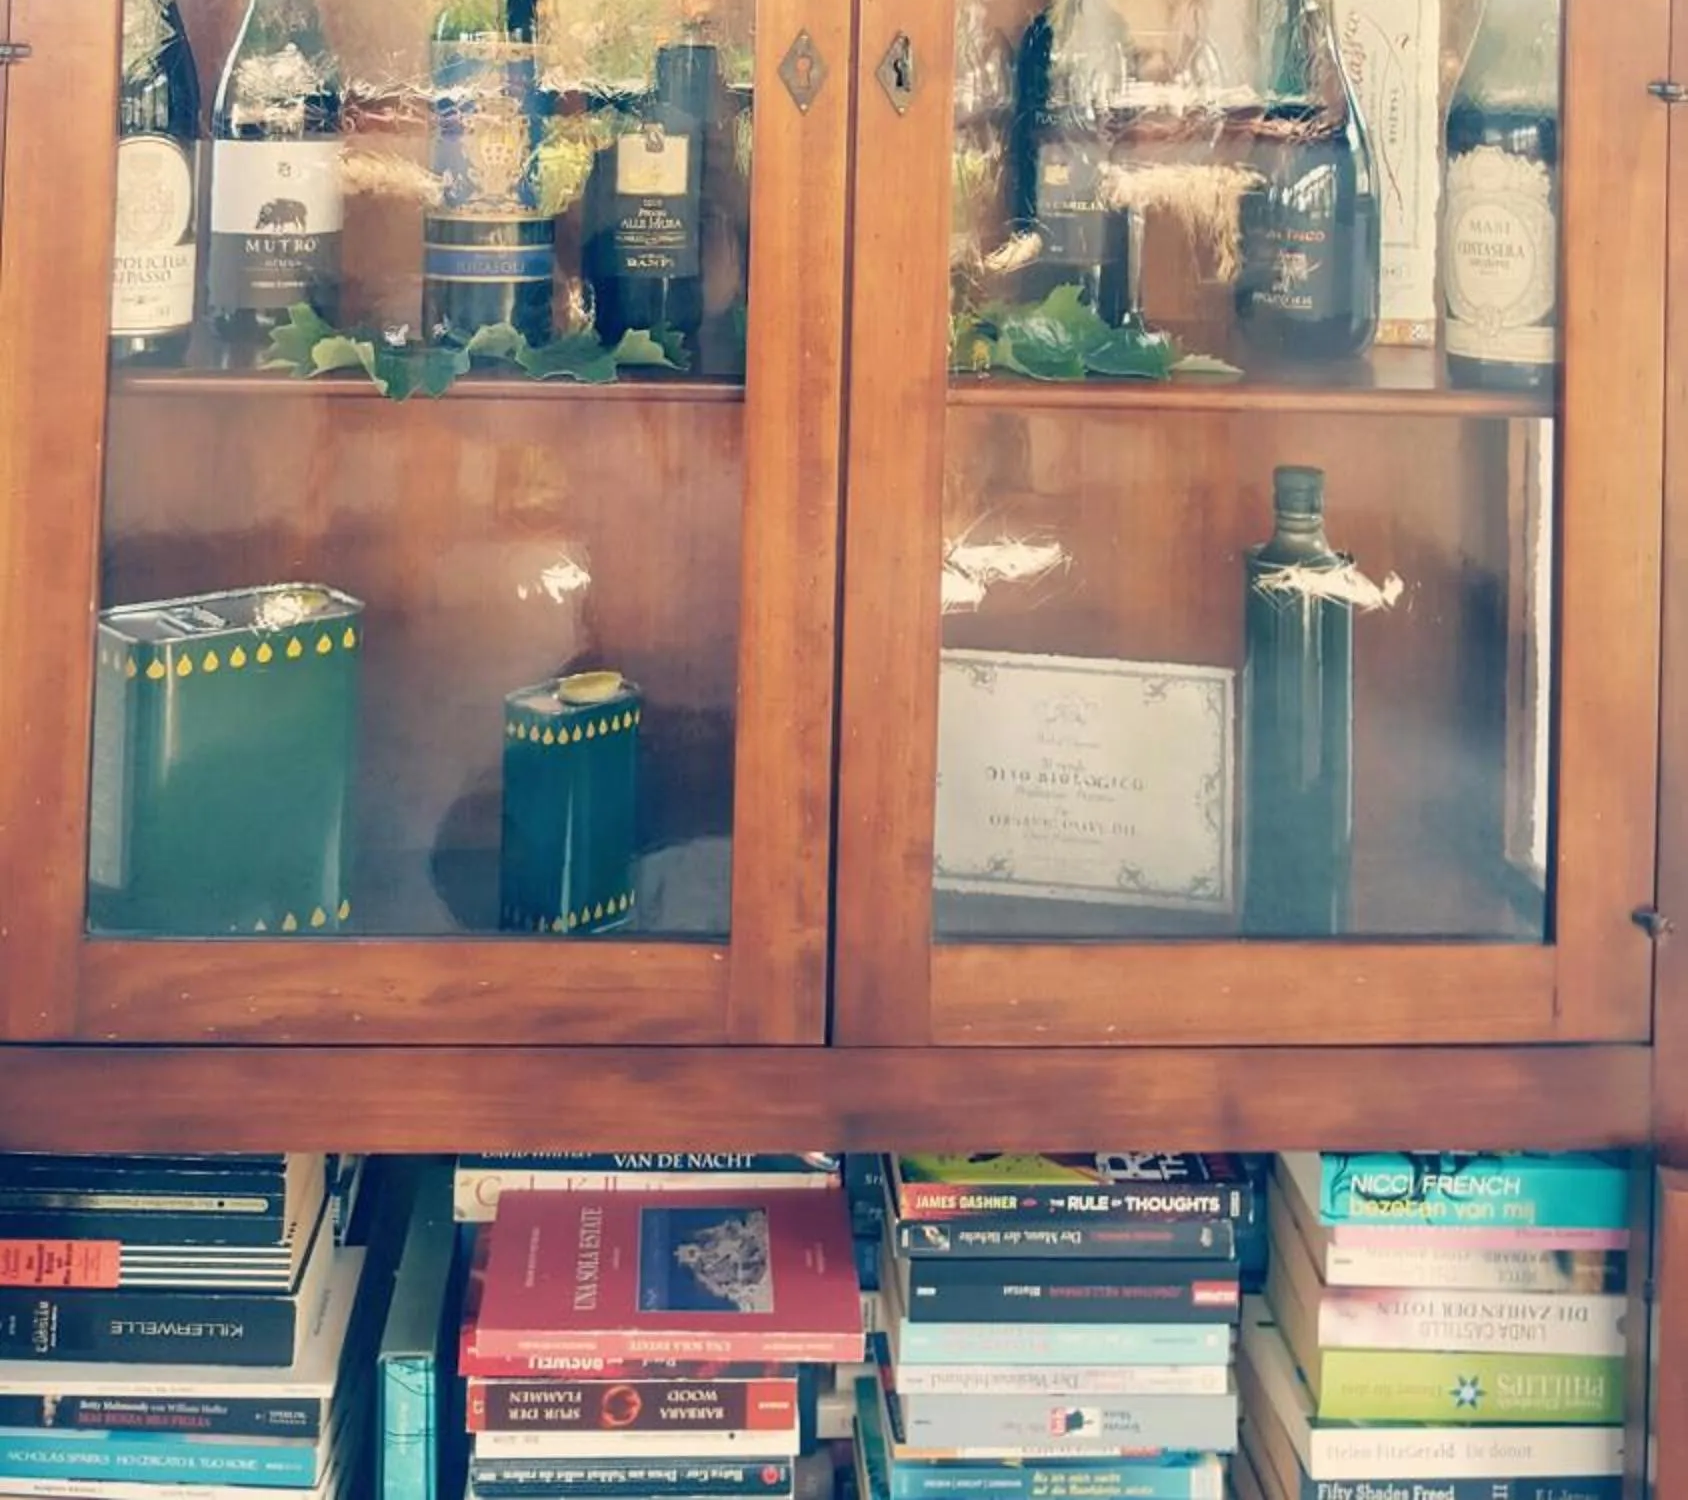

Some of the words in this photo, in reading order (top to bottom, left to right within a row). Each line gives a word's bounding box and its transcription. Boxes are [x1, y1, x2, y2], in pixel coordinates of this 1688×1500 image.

[615, 1153, 655, 1169] VAN
[658, 1154, 684, 1169] DE
[688, 1153, 754, 1168] NACHT
[1350, 1174, 1414, 1195] NICCI
[1421, 1173, 1521, 1196] FRENCH
[916, 1195, 956, 1210] JAMES
[1067, 1195, 1108, 1211] RULE
[1125, 1196, 1220, 1213] THOUGHTS
[1456, 1202, 1494, 1219] van
[1503, 1200, 1537, 1223] mij
[111, 1320, 244, 1337] KILLERWELLE
[509, 1390, 582, 1404] FLAMMEN
[666, 1390, 718, 1402] WOOD
[1318, 1484, 1353, 1500] Fifty
[1357, 1484, 1409, 1500] Shades
